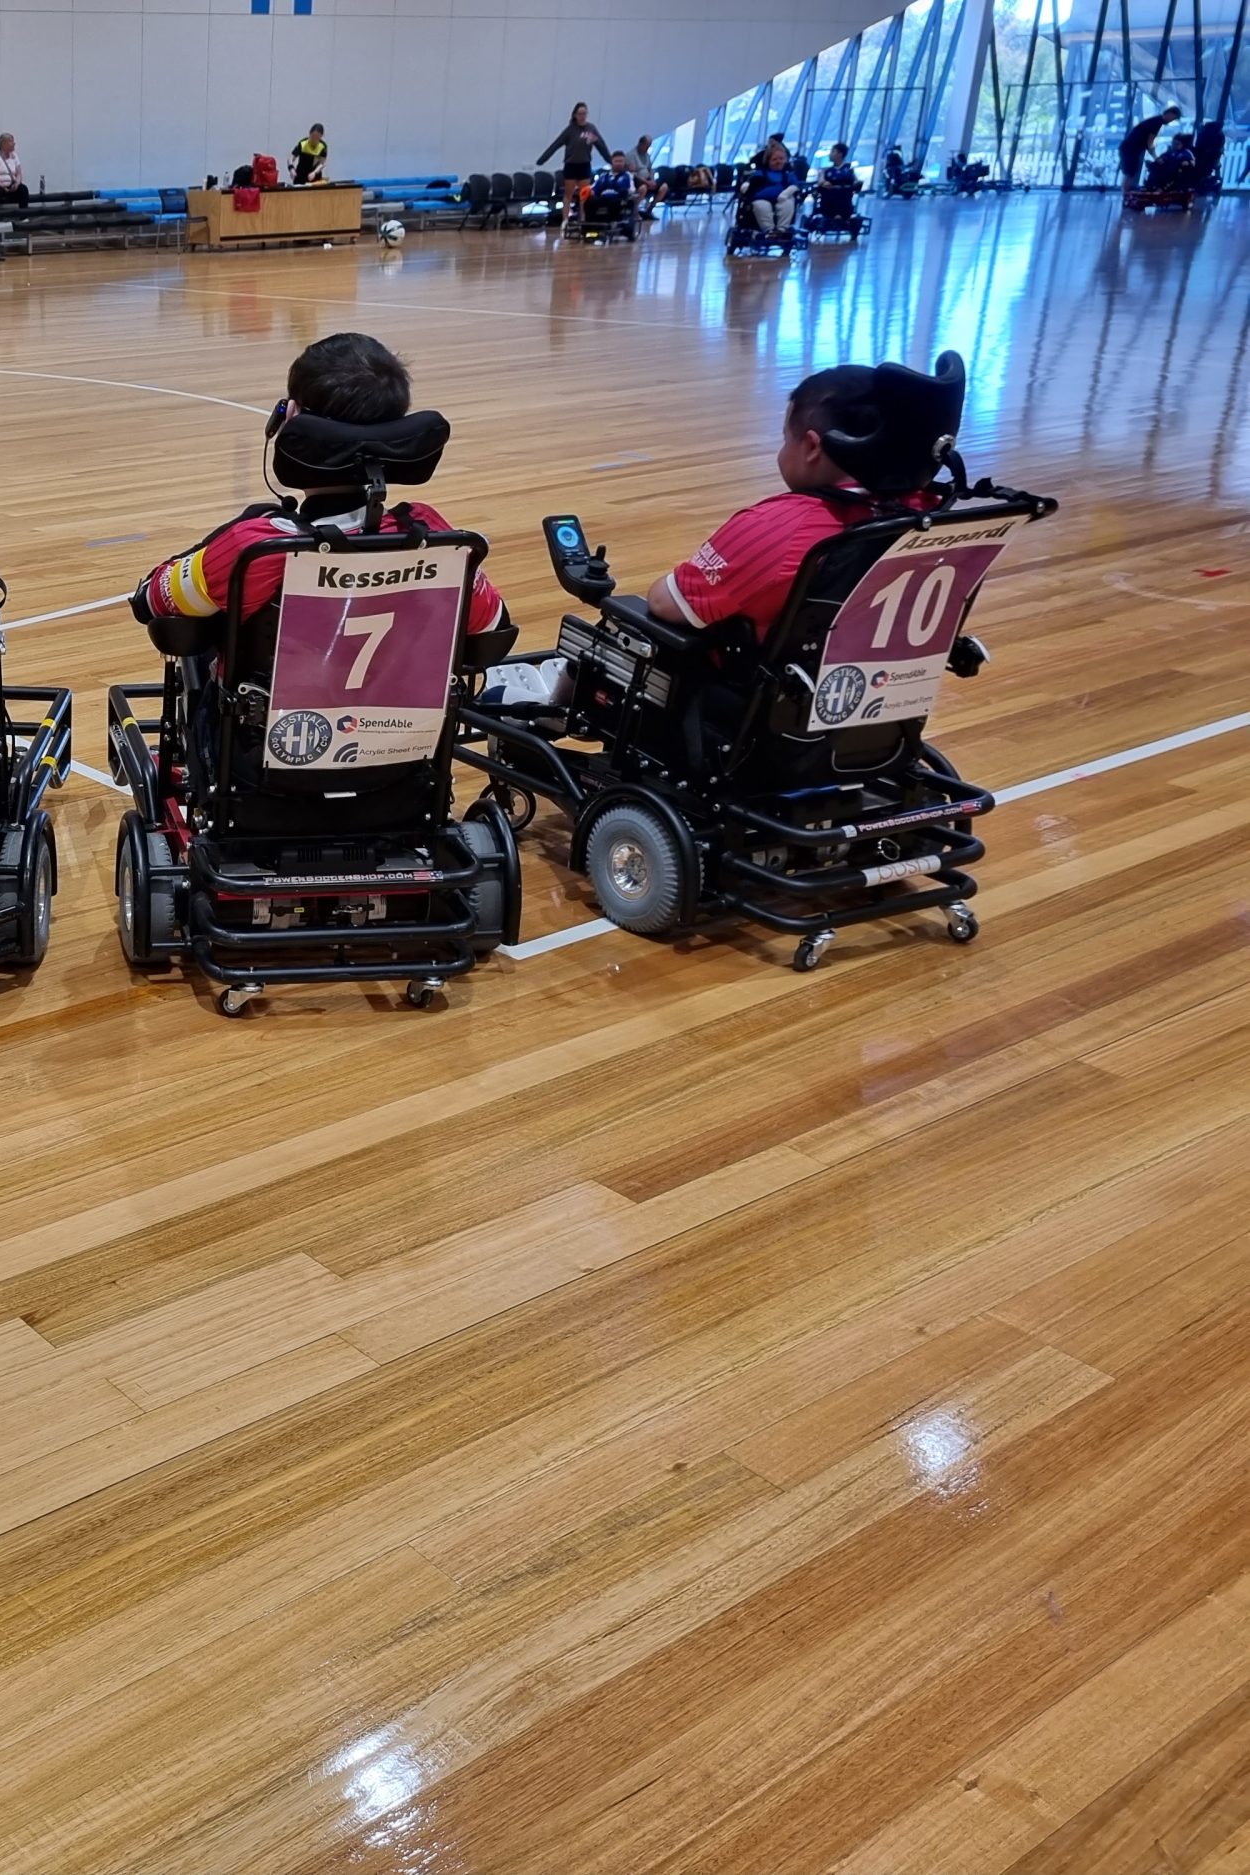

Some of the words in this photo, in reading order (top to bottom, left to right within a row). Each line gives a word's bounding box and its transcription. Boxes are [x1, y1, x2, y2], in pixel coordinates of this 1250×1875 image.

[897, 522, 1011, 551] Azzopardi
[317, 560, 438, 589] Kessaris
[869, 565, 956, 649] 10
[343, 611, 395, 690] 7
[820, 667, 864, 692] WESTVALE
[359, 717, 413, 730] SpendAble
[816, 702, 848, 722] OLYMPIC
[273, 713, 329, 735] WESTVALE
[272, 742, 314, 763] OLYMPIC
[317, 741, 327, 755] FC
[359, 748, 385, 756] Acrylic
